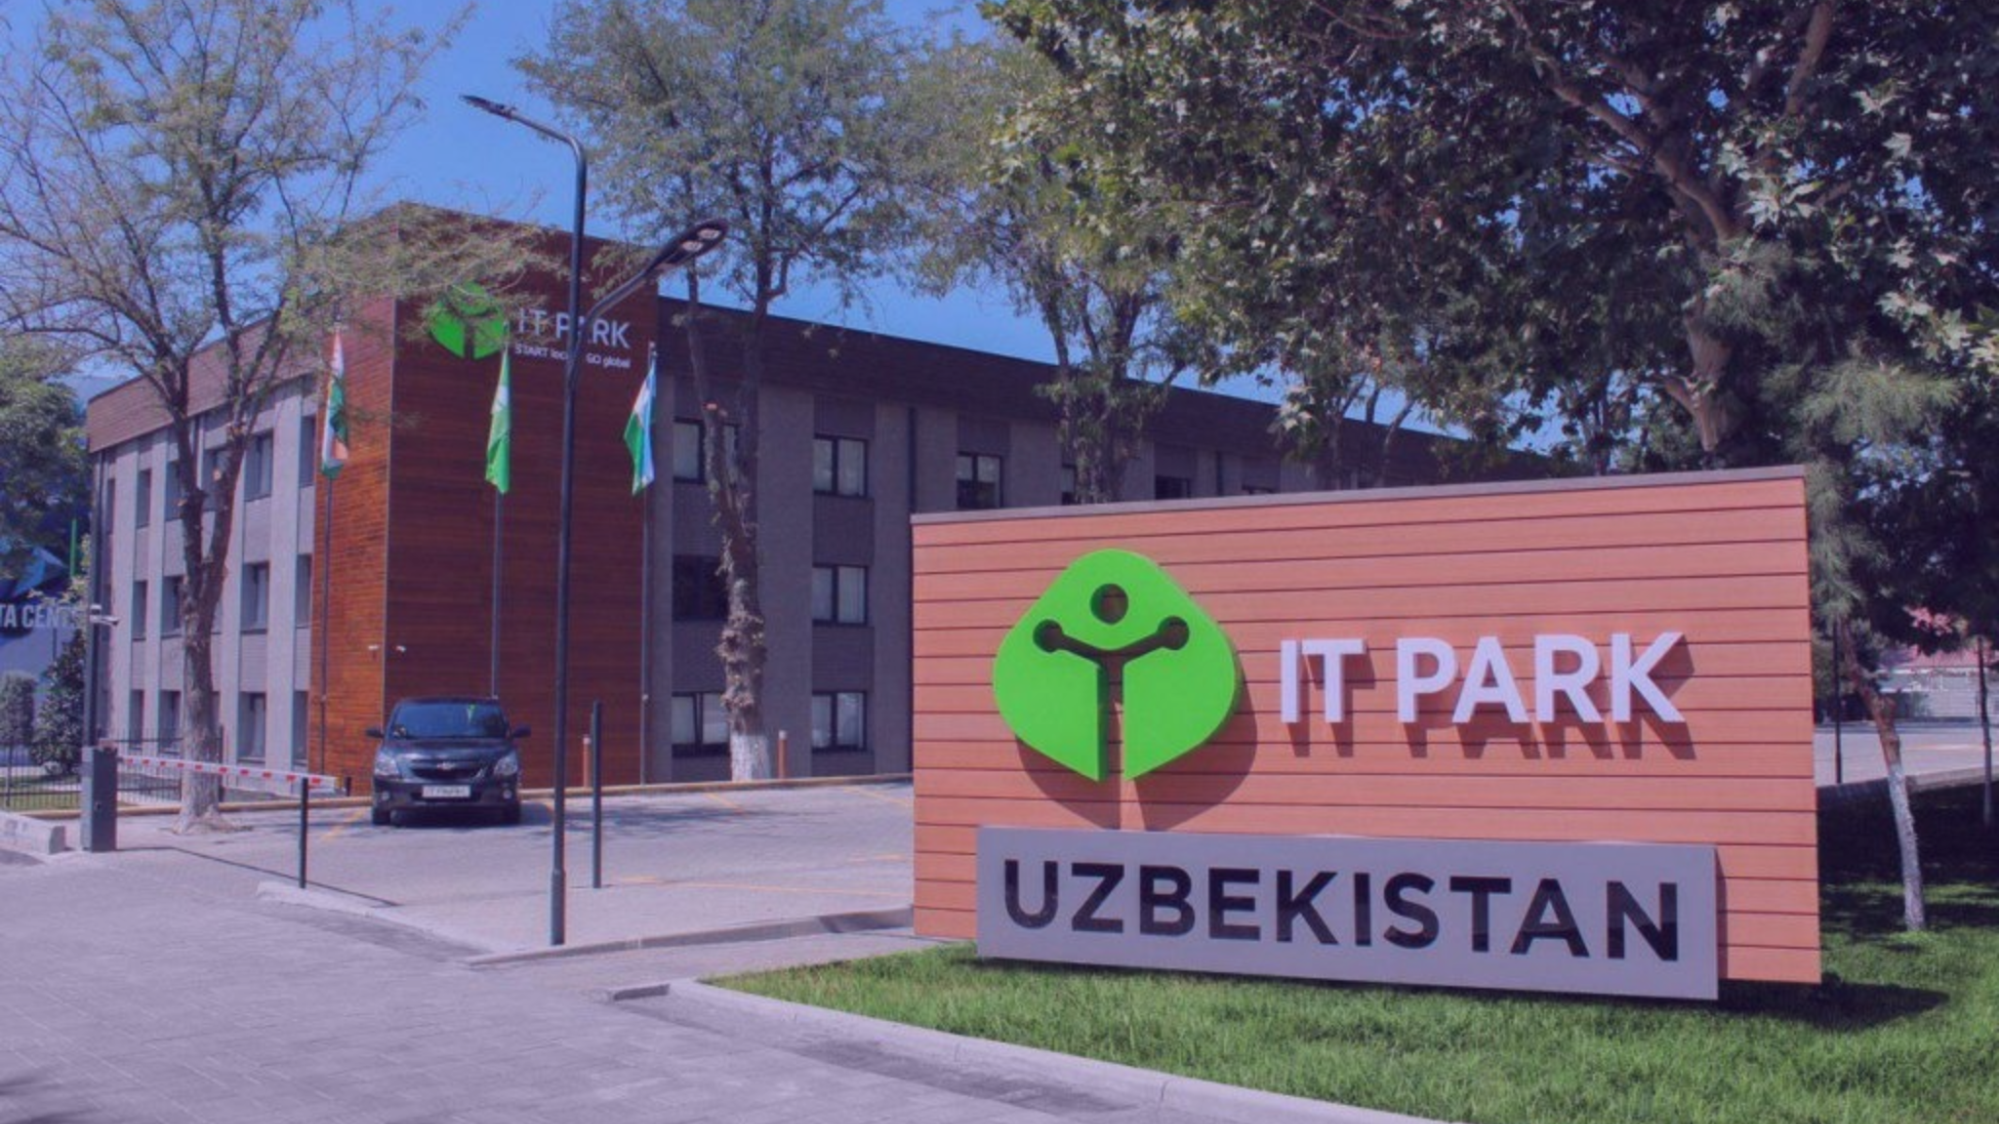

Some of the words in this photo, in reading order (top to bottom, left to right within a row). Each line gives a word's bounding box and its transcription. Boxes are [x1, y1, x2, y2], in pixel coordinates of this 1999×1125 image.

[518, 308, 547, 336] IT
[586, 353, 601, 364] GO
[603, 356, 631, 369] global
[1281, 638, 1367, 723] IT
[1397, 632, 1685, 723] PARK
[1003, 859, 1679, 962] UZBEKISTAN
